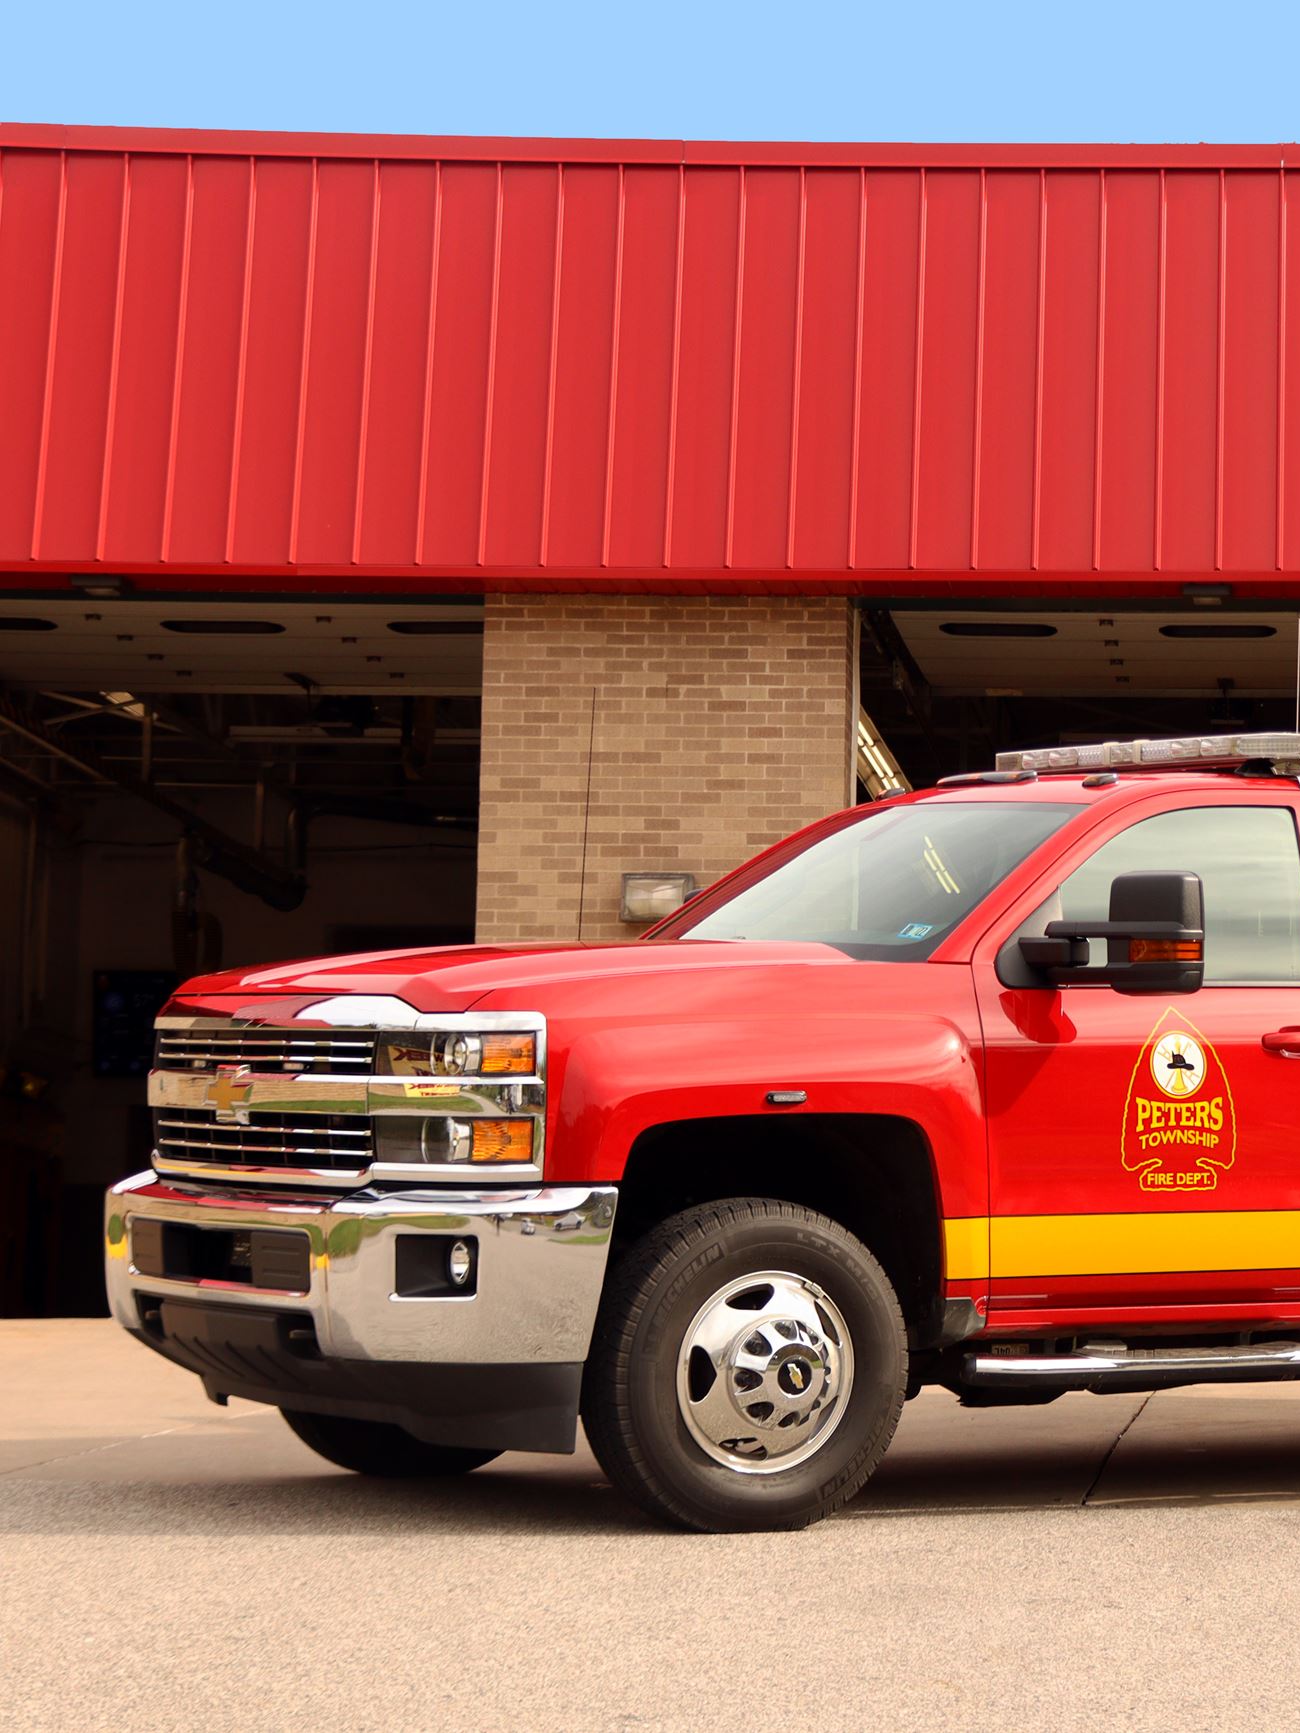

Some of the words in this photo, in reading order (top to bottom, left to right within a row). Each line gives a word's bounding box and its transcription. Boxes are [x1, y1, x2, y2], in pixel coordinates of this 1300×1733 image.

[1136, 1096, 1223, 1132] PETERS
[1139, 1129, 1219, 1149] TOWNSHIP
[1147, 1173, 1173, 1185] FIRE
[1177, 1172, 1210, 1185] DEPT.
